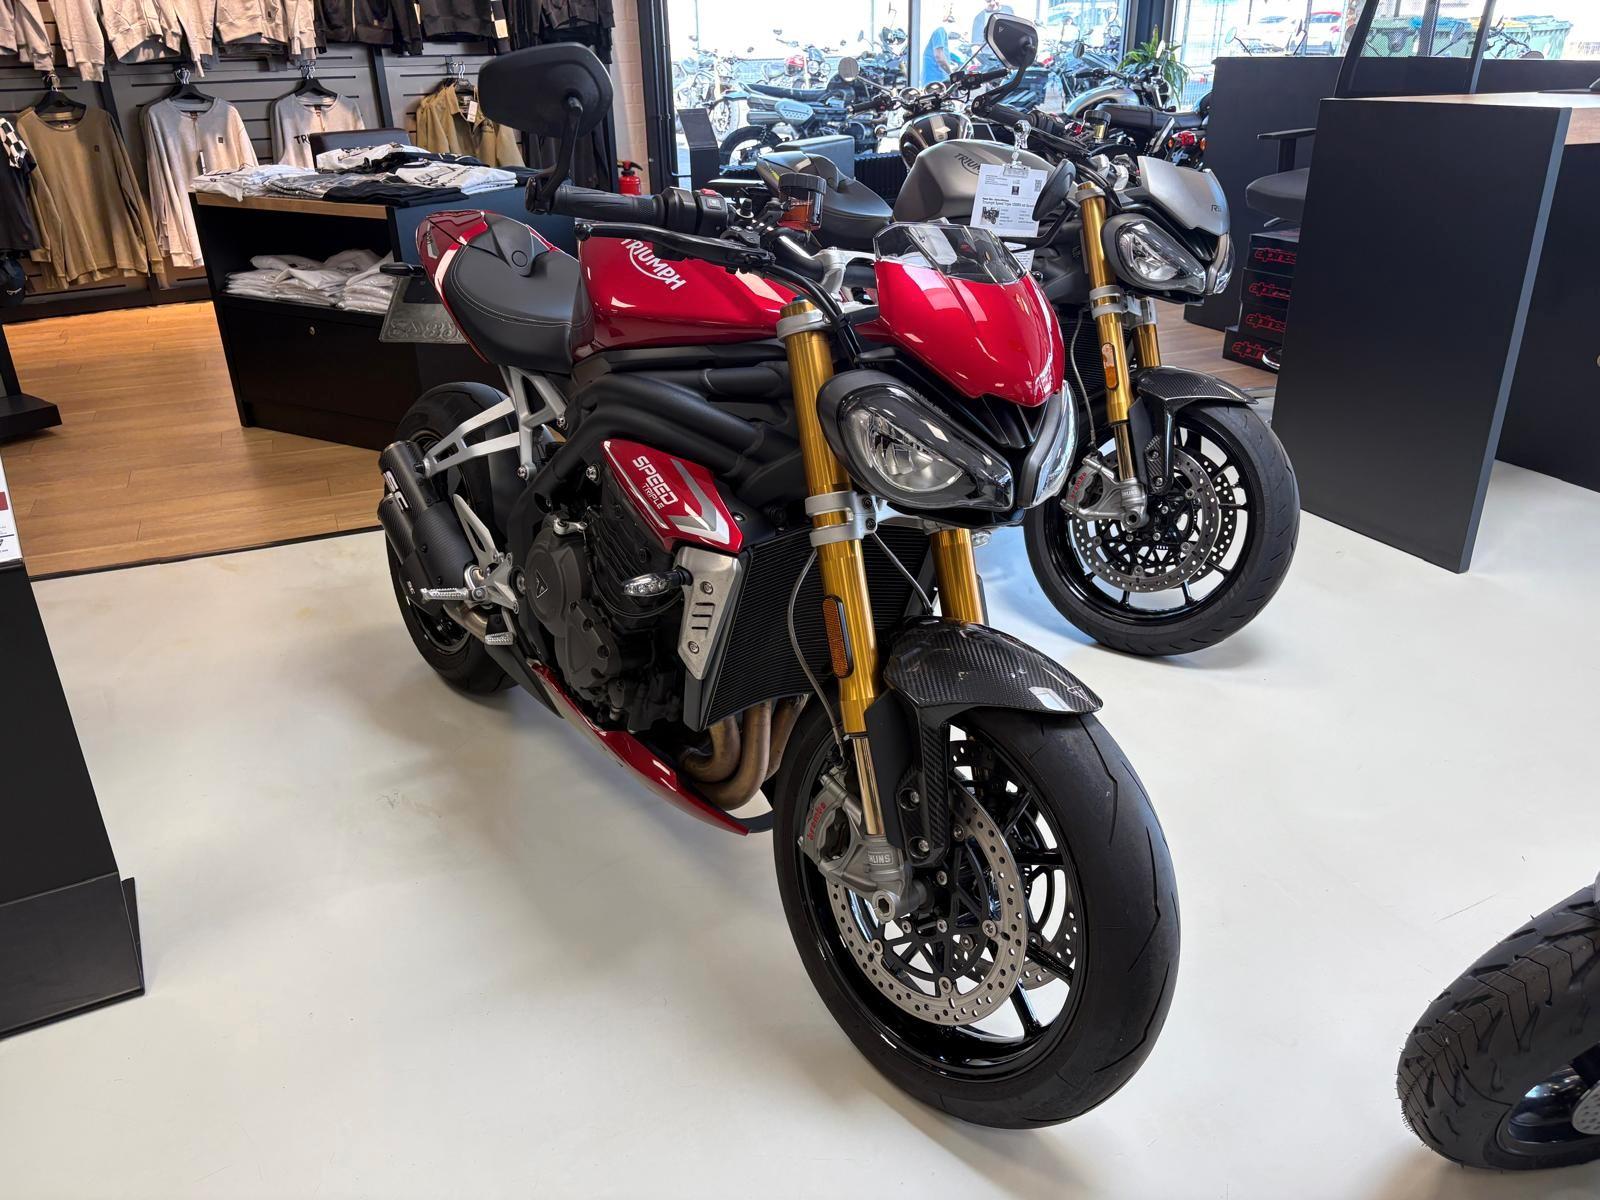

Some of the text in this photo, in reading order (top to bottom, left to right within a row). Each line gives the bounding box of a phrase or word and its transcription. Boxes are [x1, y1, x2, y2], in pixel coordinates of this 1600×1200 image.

[294, 134, 311, 145] TR
[620, 238, 687, 291] TRIUMPH
[632, 455, 679, 505] SPEED
[641, 483, 665, 510] TRIPLE
